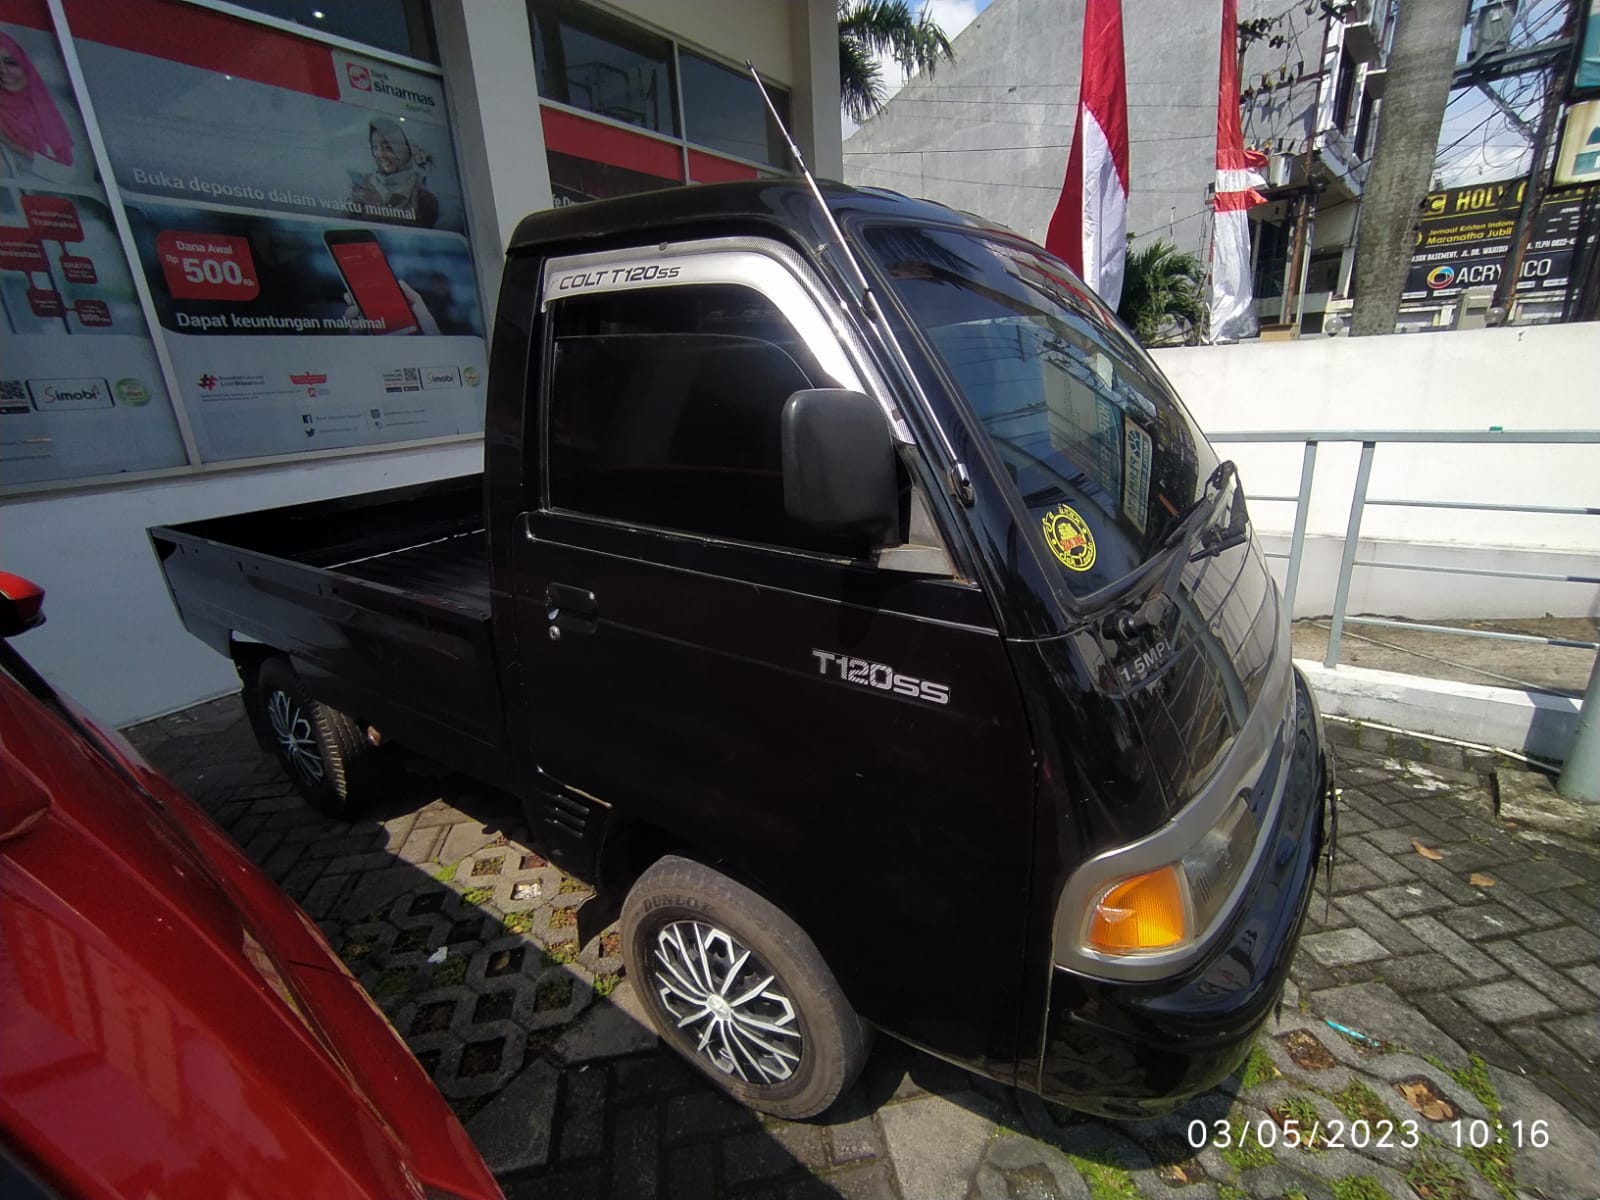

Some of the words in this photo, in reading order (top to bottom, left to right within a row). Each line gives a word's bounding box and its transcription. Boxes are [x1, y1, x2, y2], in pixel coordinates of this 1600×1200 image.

[374, 80, 435, 107] sinarmas
[132, 167, 184, 189] Buka
[189, 177, 265, 200] deposito
[269, 188, 316, 207] dalam
[320, 196, 362, 213] waktu
[365, 202, 416, 220] minimal
[176, 240, 206, 253] Dana
[208, 243, 233, 254] Awal
[1427, 231, 1484, 245] Maranatha
[182, 257, 242, 285] 500
[559, 270, 608, 290] COLT
[1456, 258, 1552, 284] ACRYICO
[176, 312, 228, 330] Dapat
[231, 313, 320, 331] keuntungan
[323, 316, 386, 329] maksimal
[812, 648, 949, 704] T120SS
